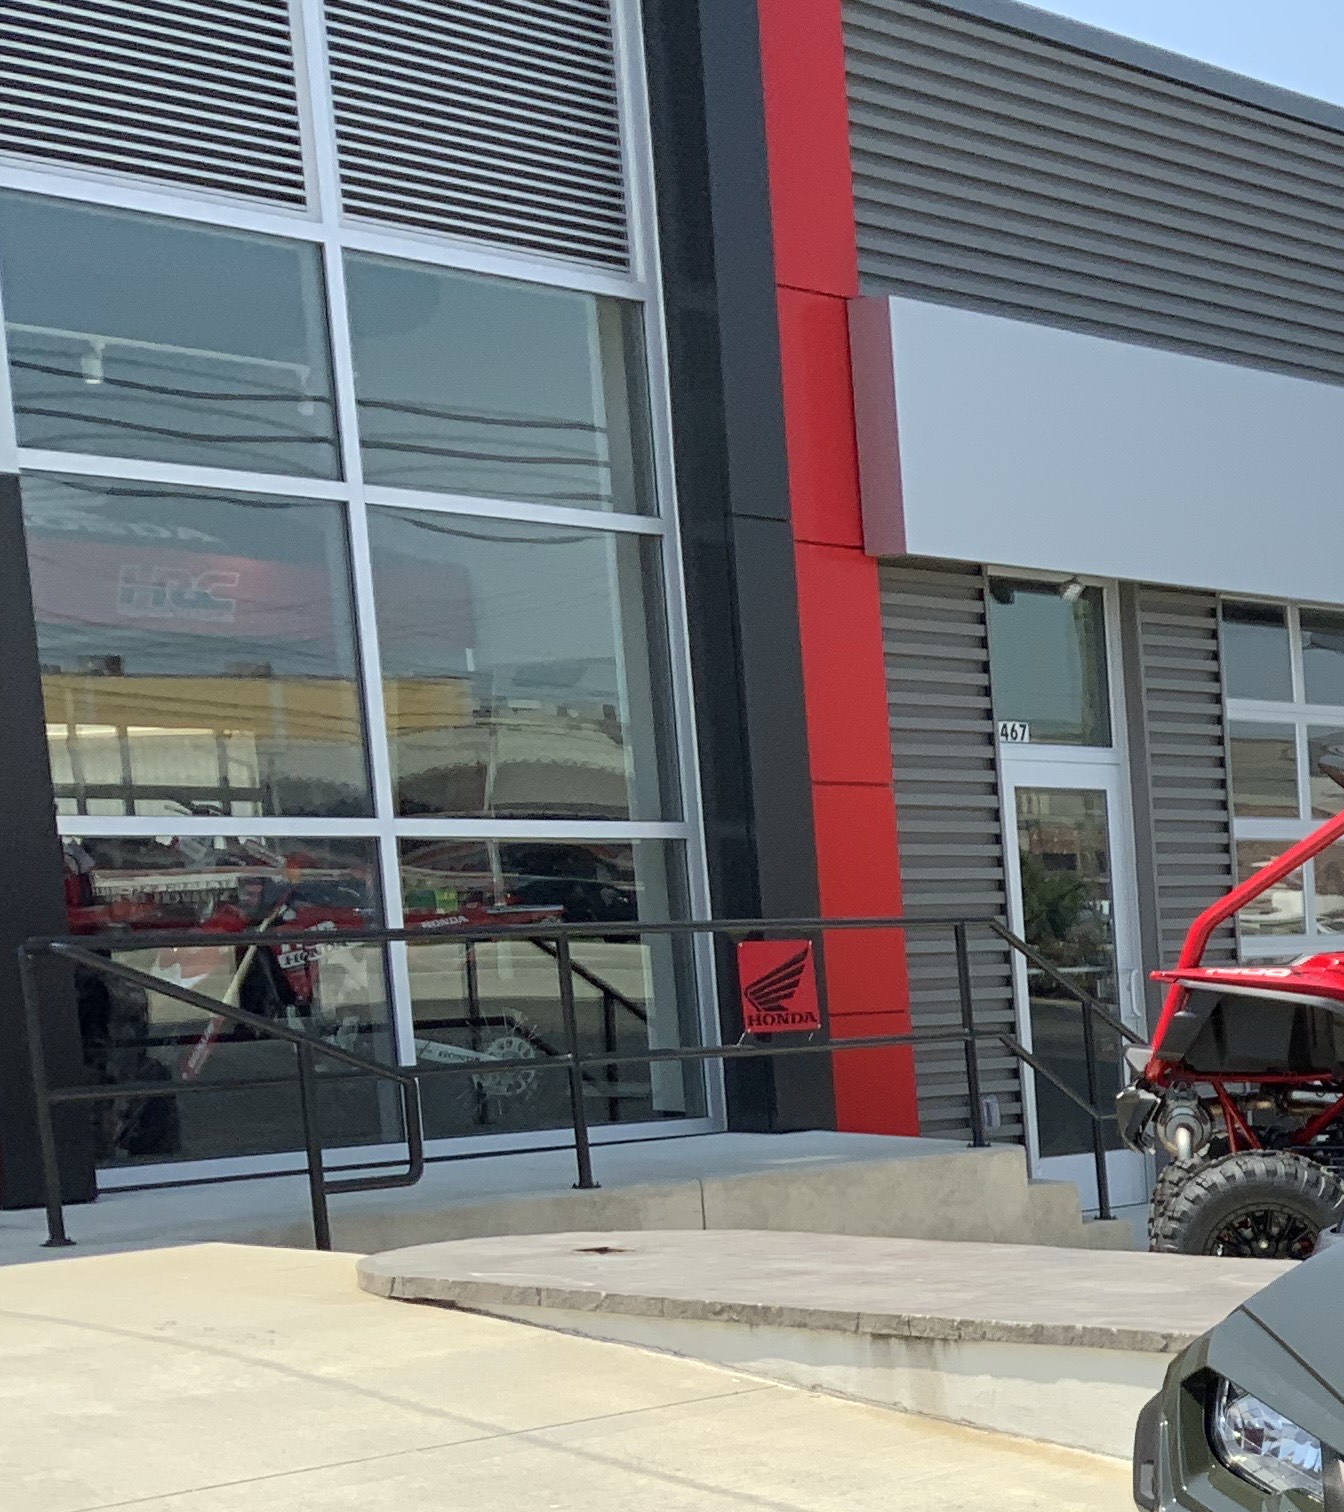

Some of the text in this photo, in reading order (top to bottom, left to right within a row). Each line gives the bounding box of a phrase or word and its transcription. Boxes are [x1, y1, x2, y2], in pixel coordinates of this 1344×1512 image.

[1000, 723, 1027, 741] 467
[421, 916, 470, 929] HONDA
[747, 1012, 818, 1026] HONDA
